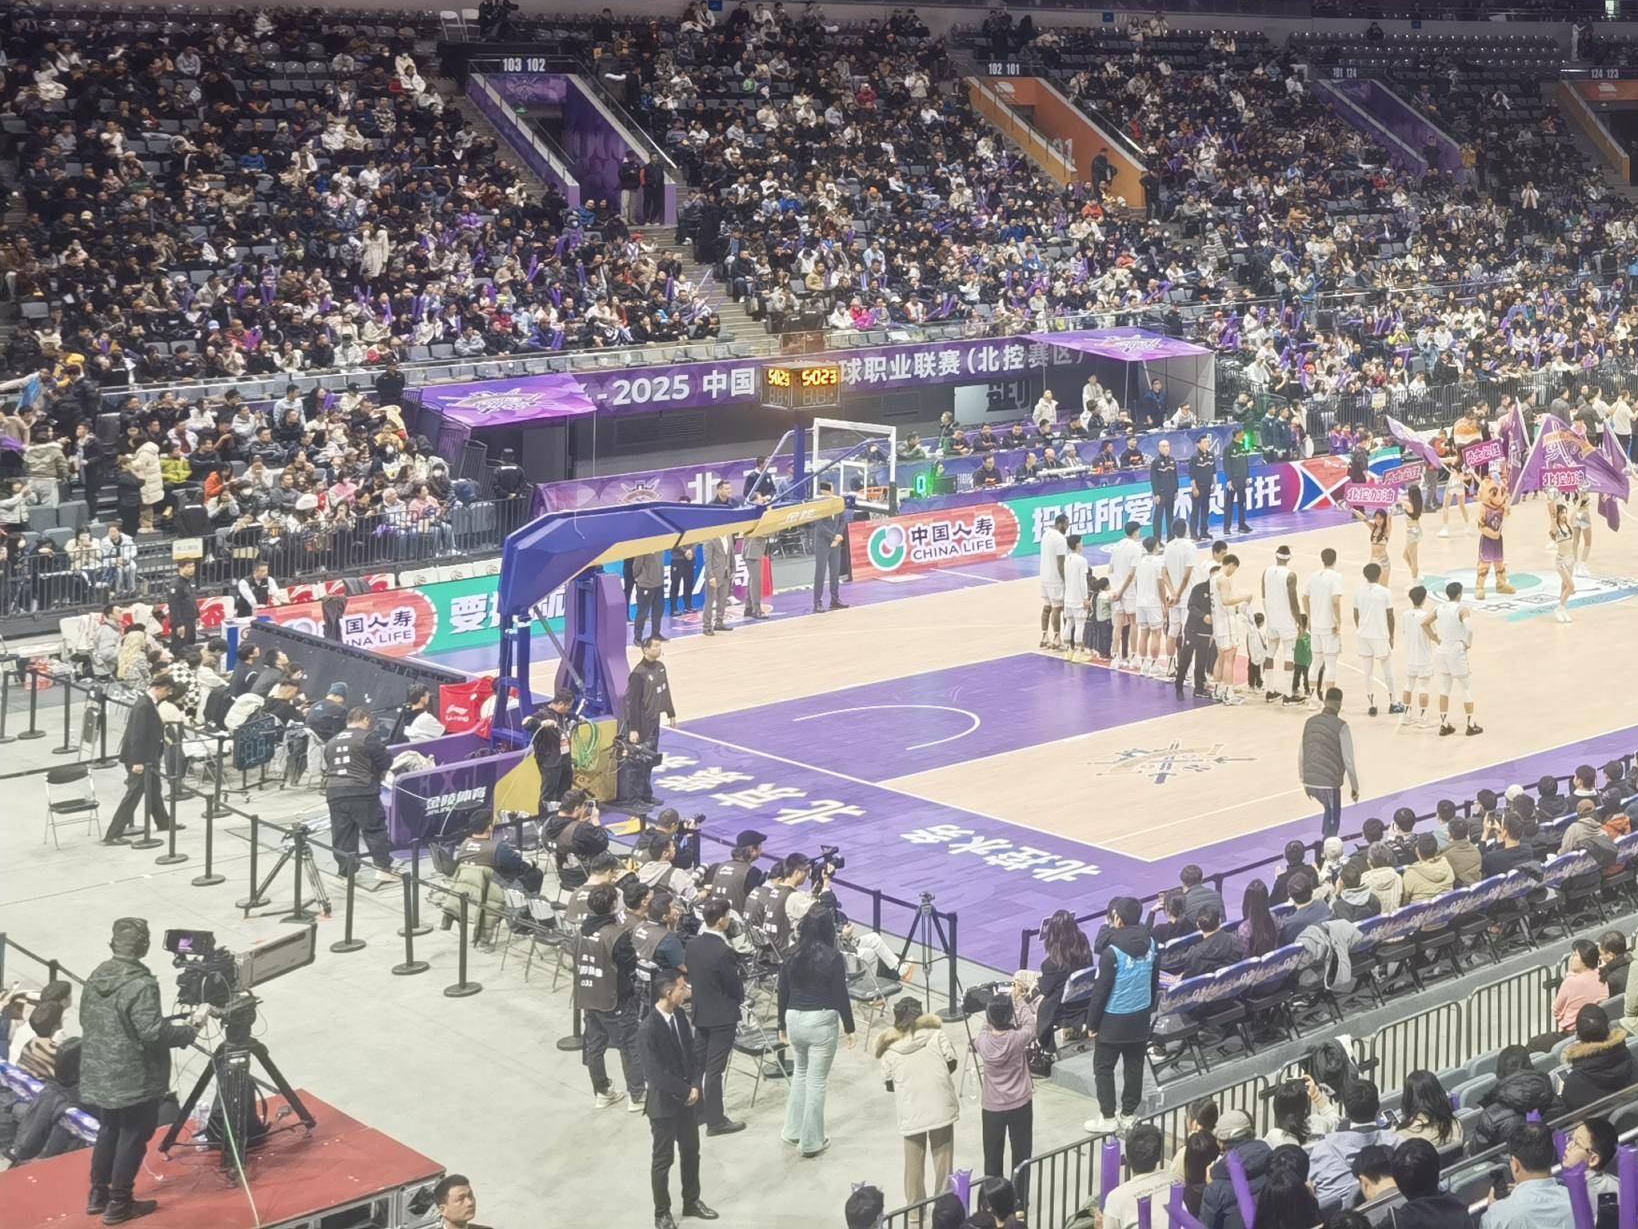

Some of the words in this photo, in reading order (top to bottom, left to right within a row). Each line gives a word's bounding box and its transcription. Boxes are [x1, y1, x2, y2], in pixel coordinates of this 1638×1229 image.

[503, 58, 523, 72] 103
[526, 58, 546, 72] 102
[988, 63, 1003, 76] 102
[1005, 63, 1020, 76] 101
[703, 367, 755, 399] 中国
[1346, 486, 1395, 505] 北控加油
[910, 516, 993, 546] 中国人寿
[912, 544, 959, 561] CHINA
[963, 539, 994, 555] LIFE
[345, 612, 414, 636] 国人寿
[379, 628, 412, 644] LIFE
